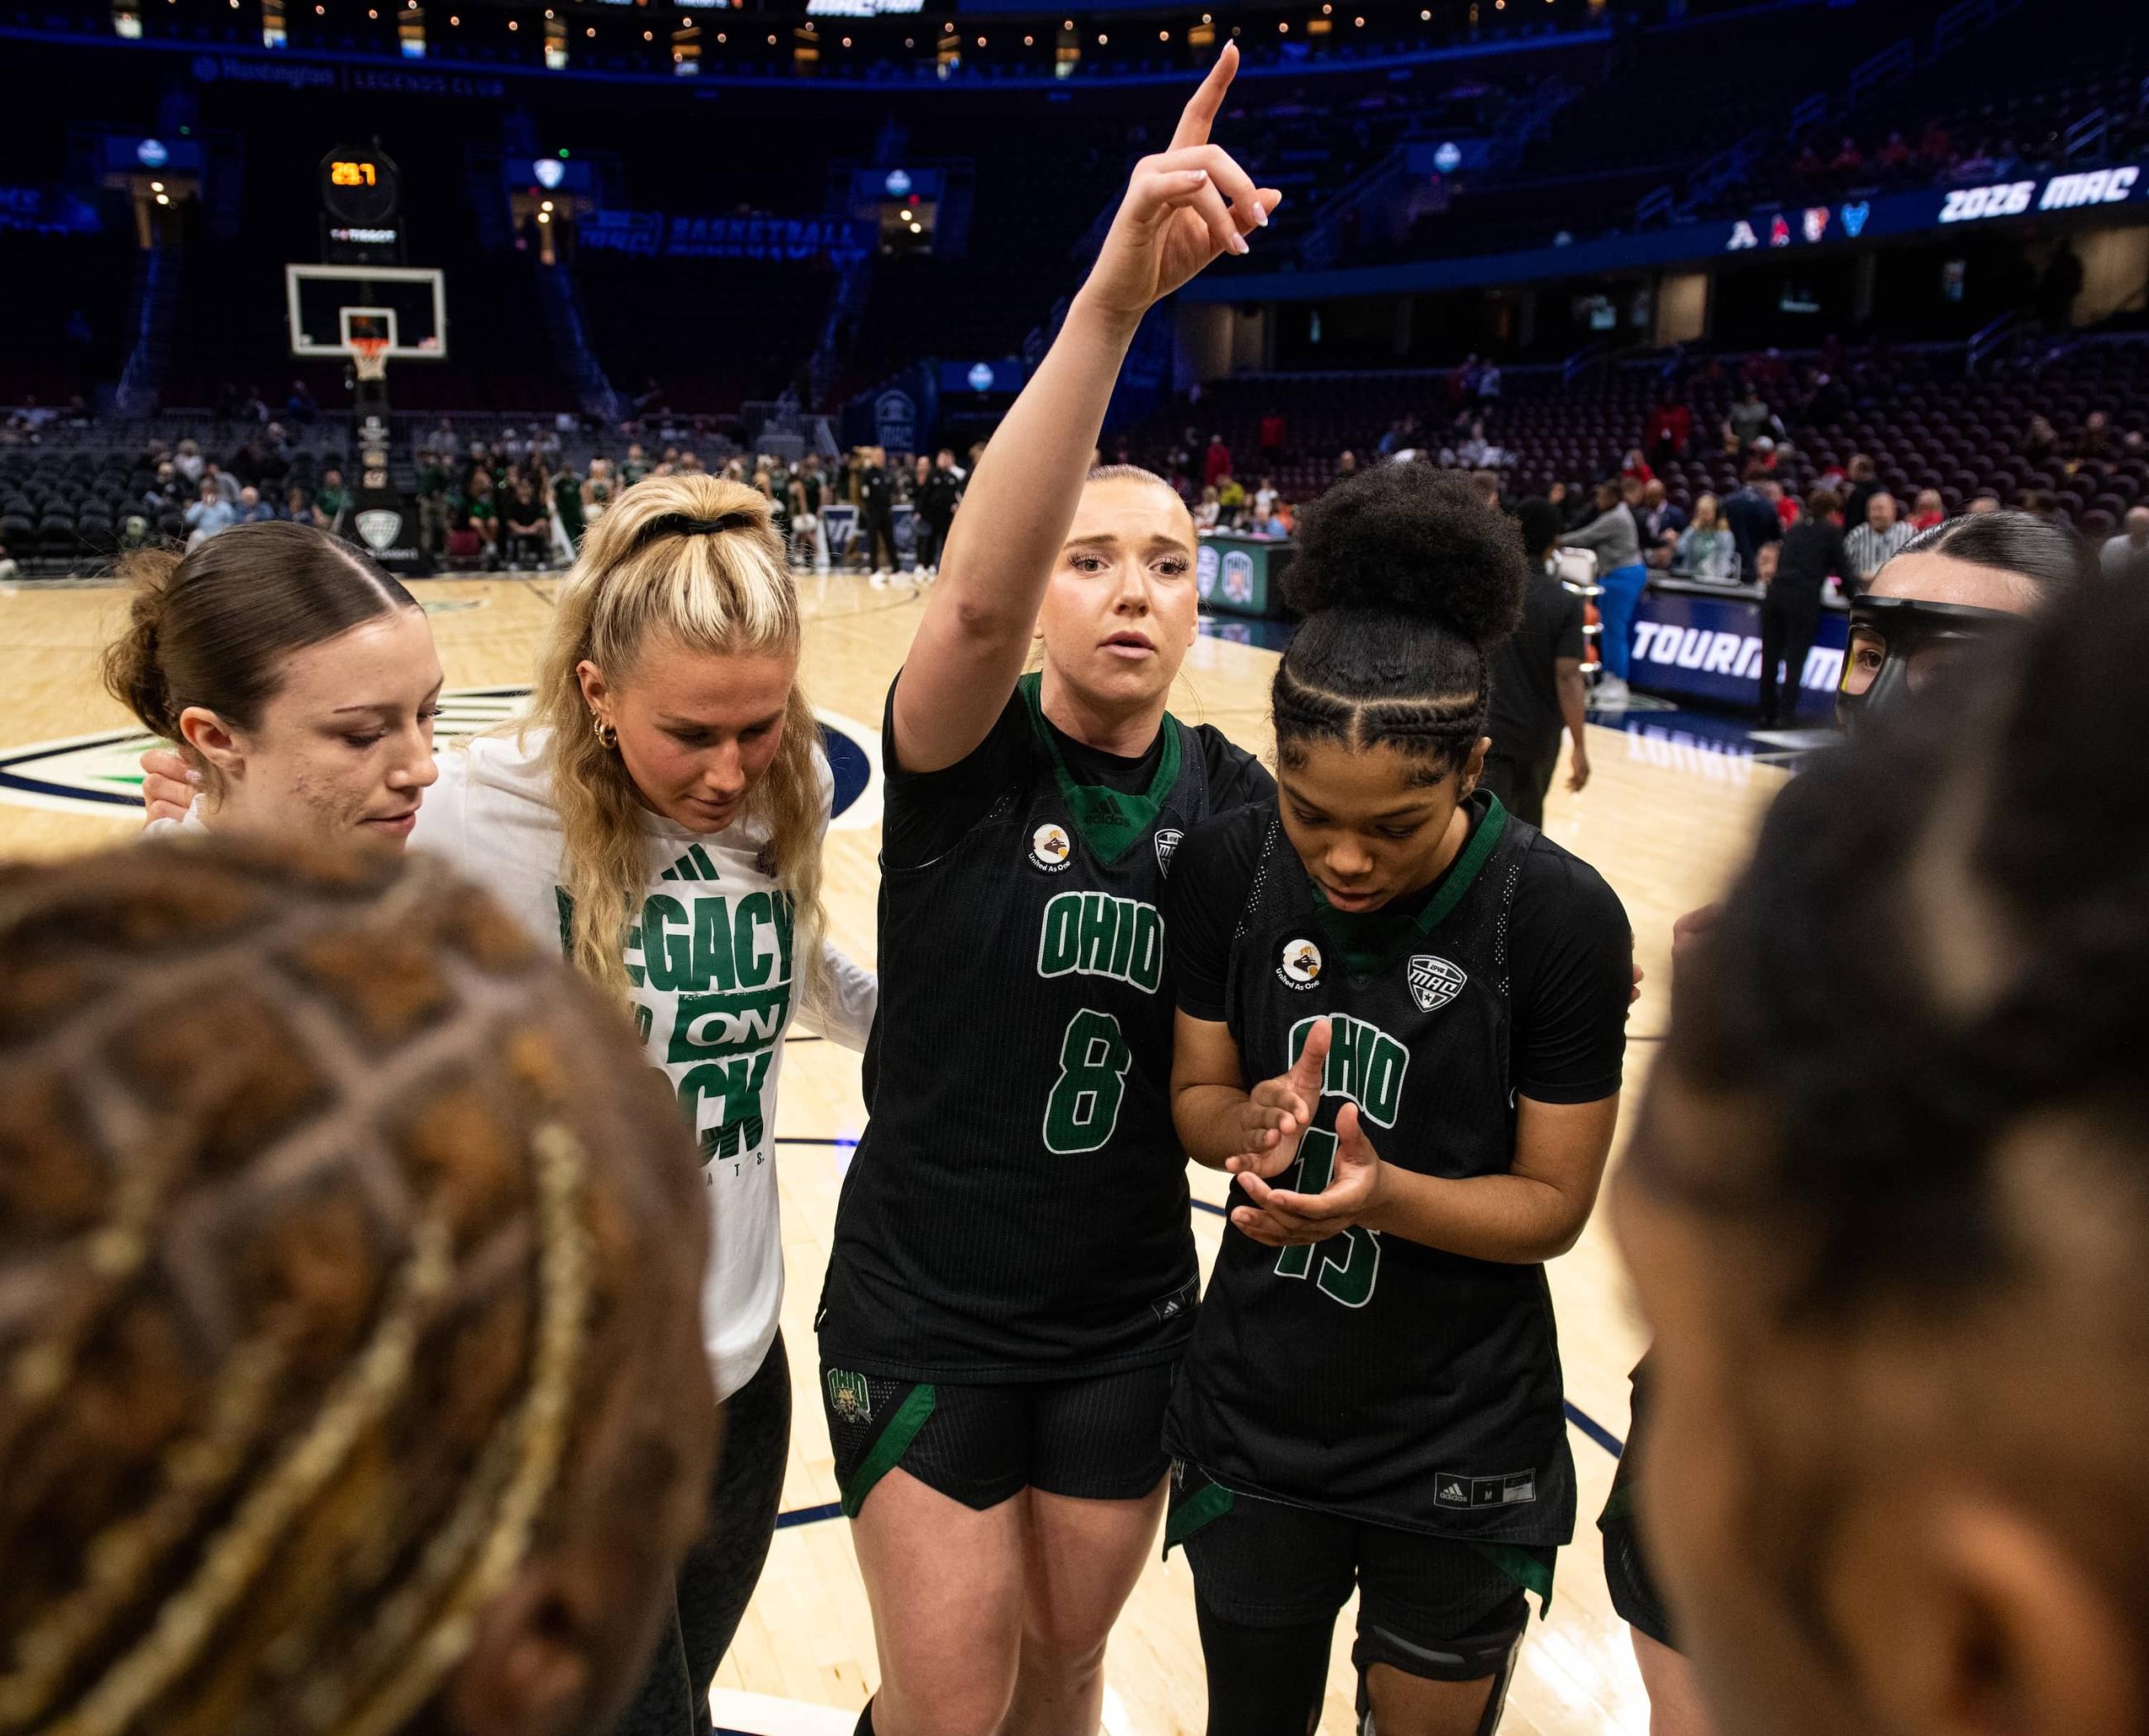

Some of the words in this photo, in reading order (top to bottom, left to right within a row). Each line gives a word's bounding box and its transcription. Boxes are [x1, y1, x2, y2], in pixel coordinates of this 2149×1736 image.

[1938, 181, 2036, 223] 2026
[2038, 166, 2140, 211] MAC
[1028, 852, 1048, 871] United
[1057, 861, 1071, 871] One
[1037, 890, 1165, 994] OHIO
[1275, 967, 1295, 989] United
[1294, 983, 1304, 991] As
[1304, 980, 1320, 990] One
[1408, 969, 1459, 997] MAC
[685, 1003, 781, 1047] ON
[1041, 1007, 1132, 1155] 8
[1439, 1491, 1468, 1503] adidas
[1484, 1490, 1493, 1501] M
